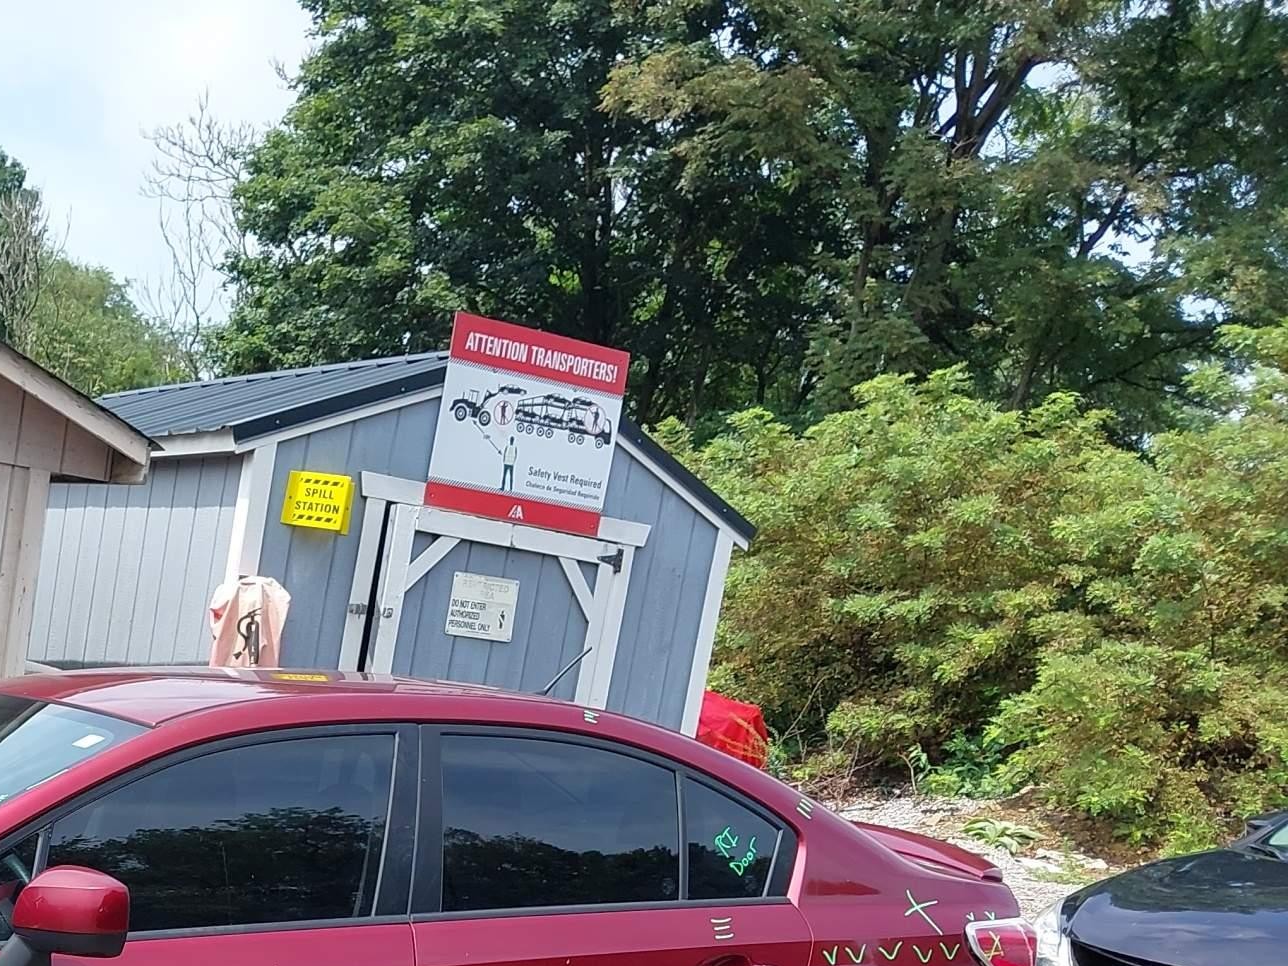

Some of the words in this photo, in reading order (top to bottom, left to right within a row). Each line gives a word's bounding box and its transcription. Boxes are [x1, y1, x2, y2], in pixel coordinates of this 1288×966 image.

[465, 332, 528, 363] ATTENTION
[531, 346, 618, 383] TRANSPORTERS!
[528, 466, 551, 481] Safety
[553, 471, 569, 482] Vest
[570, 474, 602, 489] Required
[305, 487, 334, 500] SPILL
[295, 501, 340, 514] STATION
[452, 598, 459, 607] DO
[460, 600, 469, 609] NOT
[471, 601, 486, 610] ENTER
[448, 619, 476, 630] PERSONNEL
[478, 622, 490, 631] ONLY
